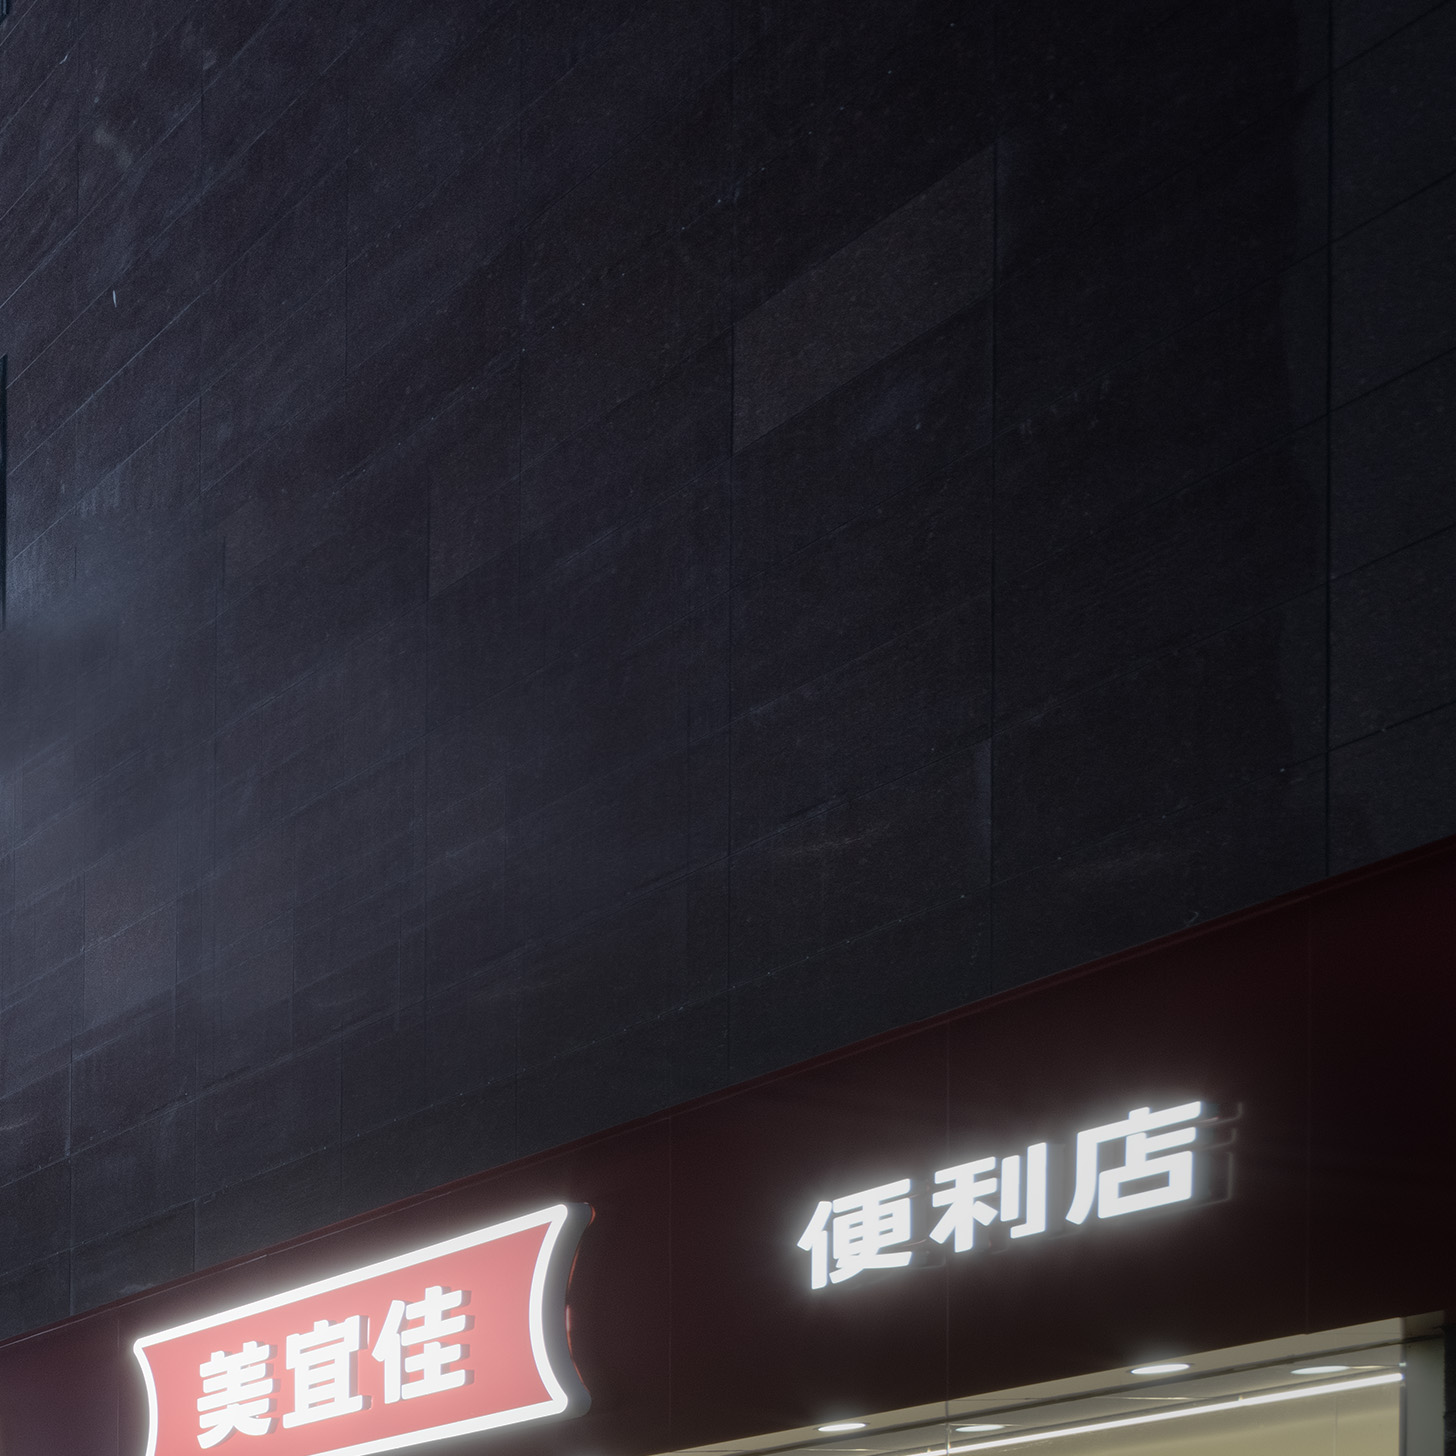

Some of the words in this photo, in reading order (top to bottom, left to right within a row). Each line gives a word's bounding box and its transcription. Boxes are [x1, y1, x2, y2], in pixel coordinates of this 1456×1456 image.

[797, 1101, 1201, 1290] 便利店
[196, 1288, 470, 1450] 美宜佳
